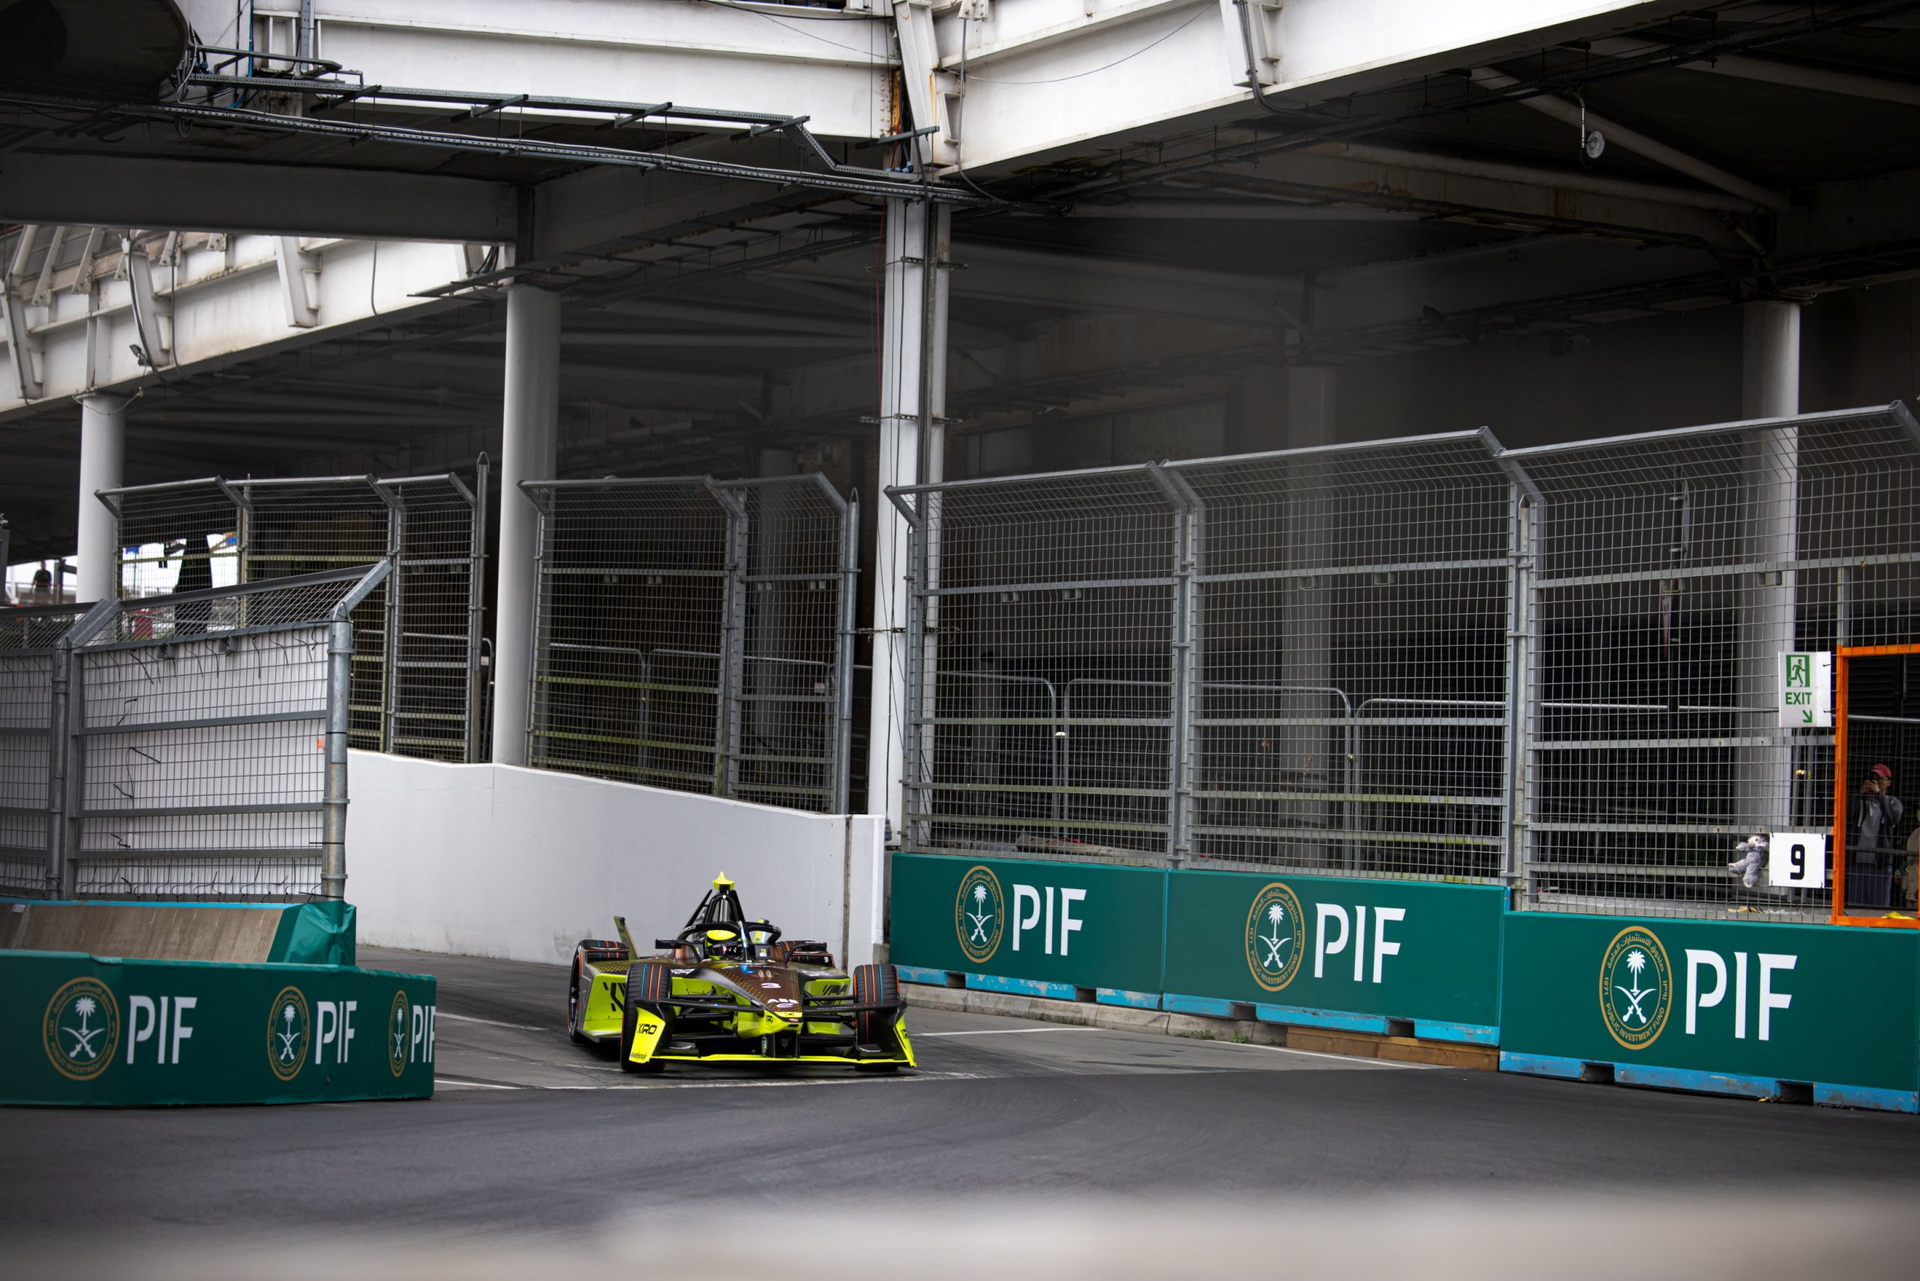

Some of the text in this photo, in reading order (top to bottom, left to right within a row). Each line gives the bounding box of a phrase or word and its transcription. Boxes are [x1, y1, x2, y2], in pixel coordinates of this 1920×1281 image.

[1785, 691, 1813, 705] EXIT
[1789, 843, 1806, 881] 9
[1012, 883, 1087, 956] PIF
[1314, 903, 1407, 984] PIF
[1250, 950, 1299, 984] PUBLIC INVESTMENT FUND
[1684, 948, 1798, 1041] PIF
[127, 995, 197, 1064] PIF
[315, 1000, 357, 1065] PIF
[411, 1004, 435, 1063] PIF
[1605, 1003, 1665, 1042] PUBLIC INVESTMENT FUND
